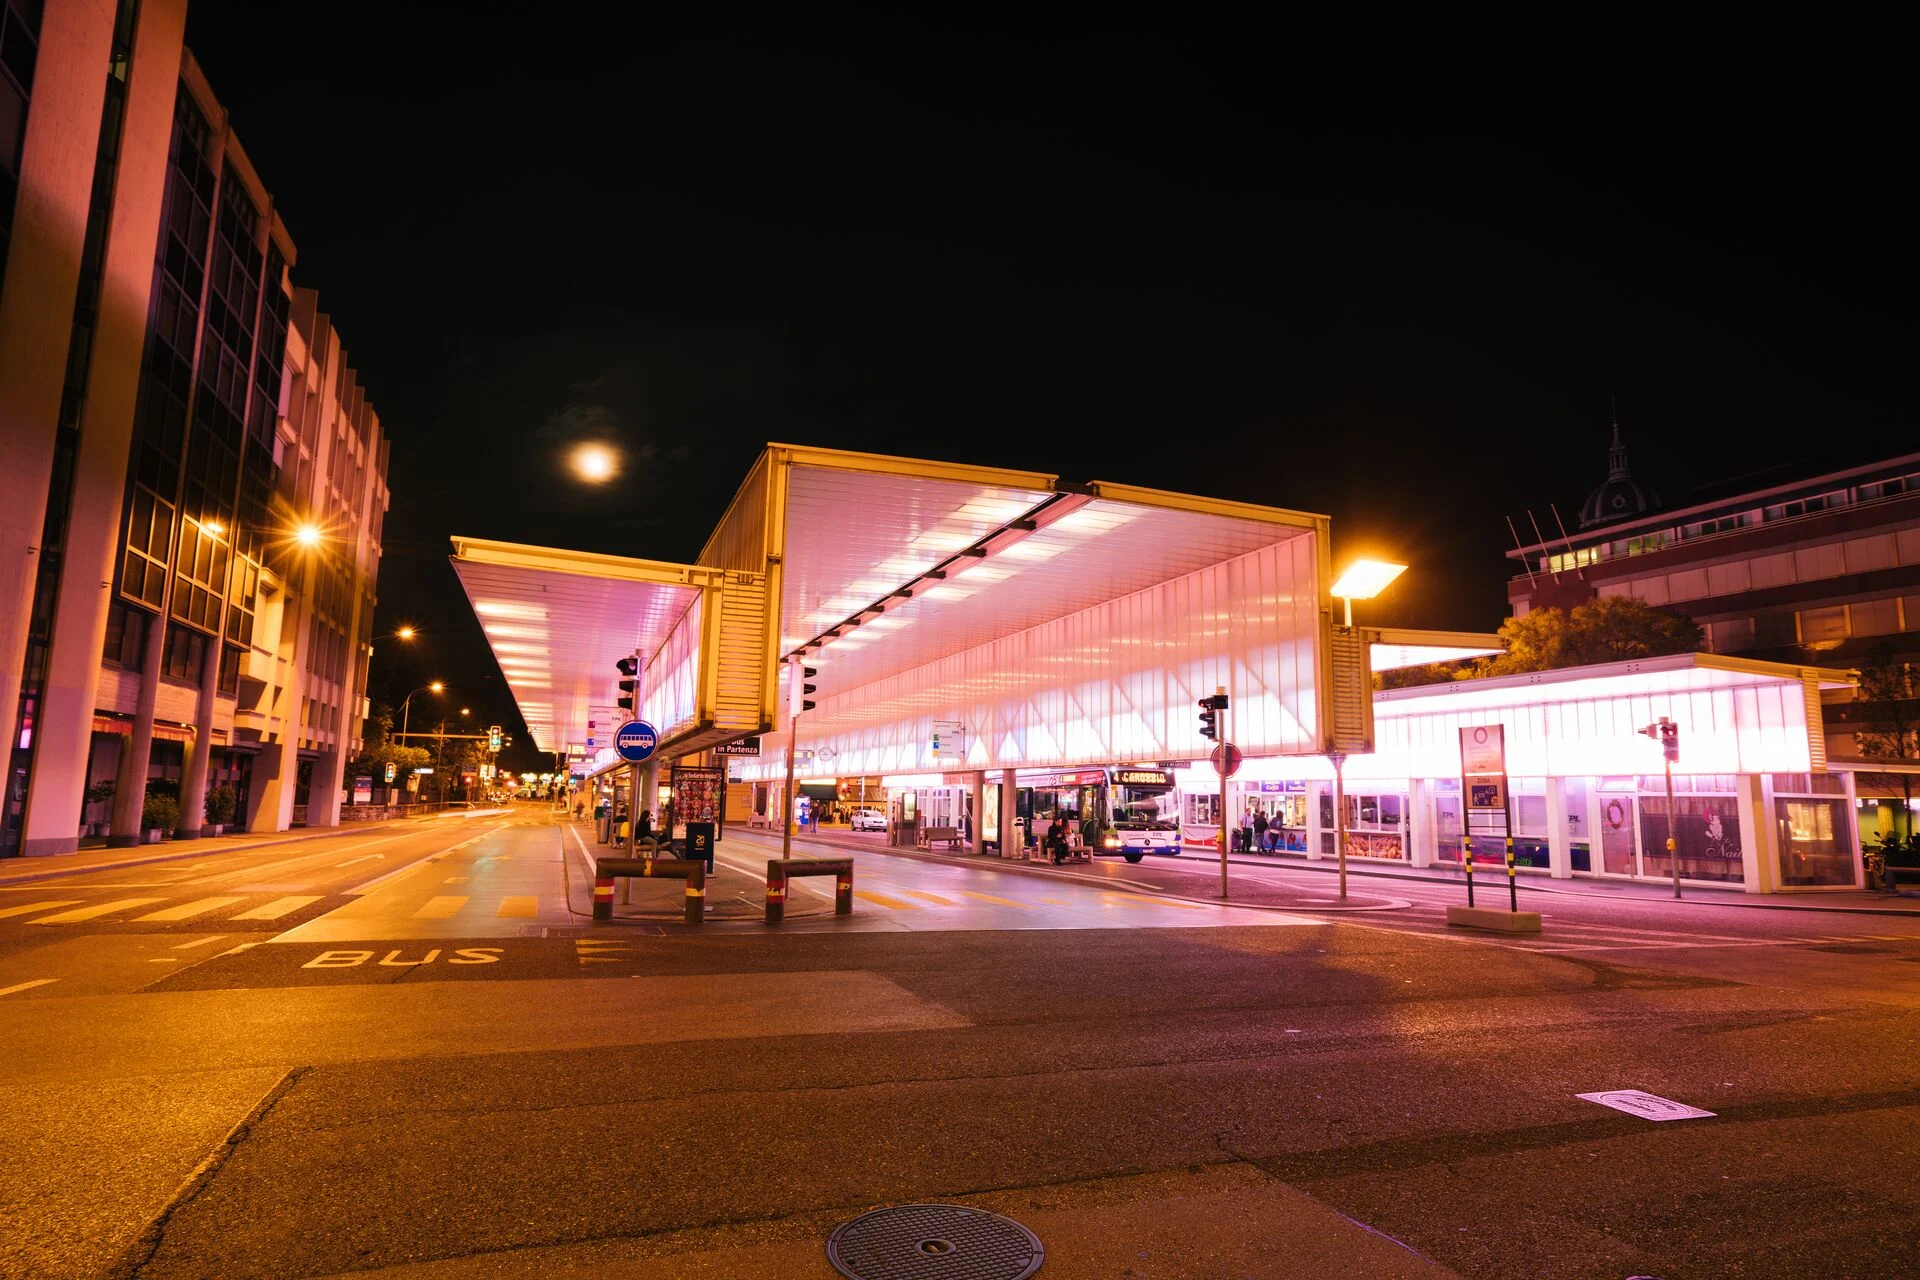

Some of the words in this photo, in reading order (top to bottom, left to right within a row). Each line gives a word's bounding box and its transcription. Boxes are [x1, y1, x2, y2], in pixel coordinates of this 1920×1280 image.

[726, 745, 758, 754] Partenza
[1113, 772, 1120, 782] 4
[1476, 777, 1491, 785] ZONA
[299, 947, 505, 969] BUS
